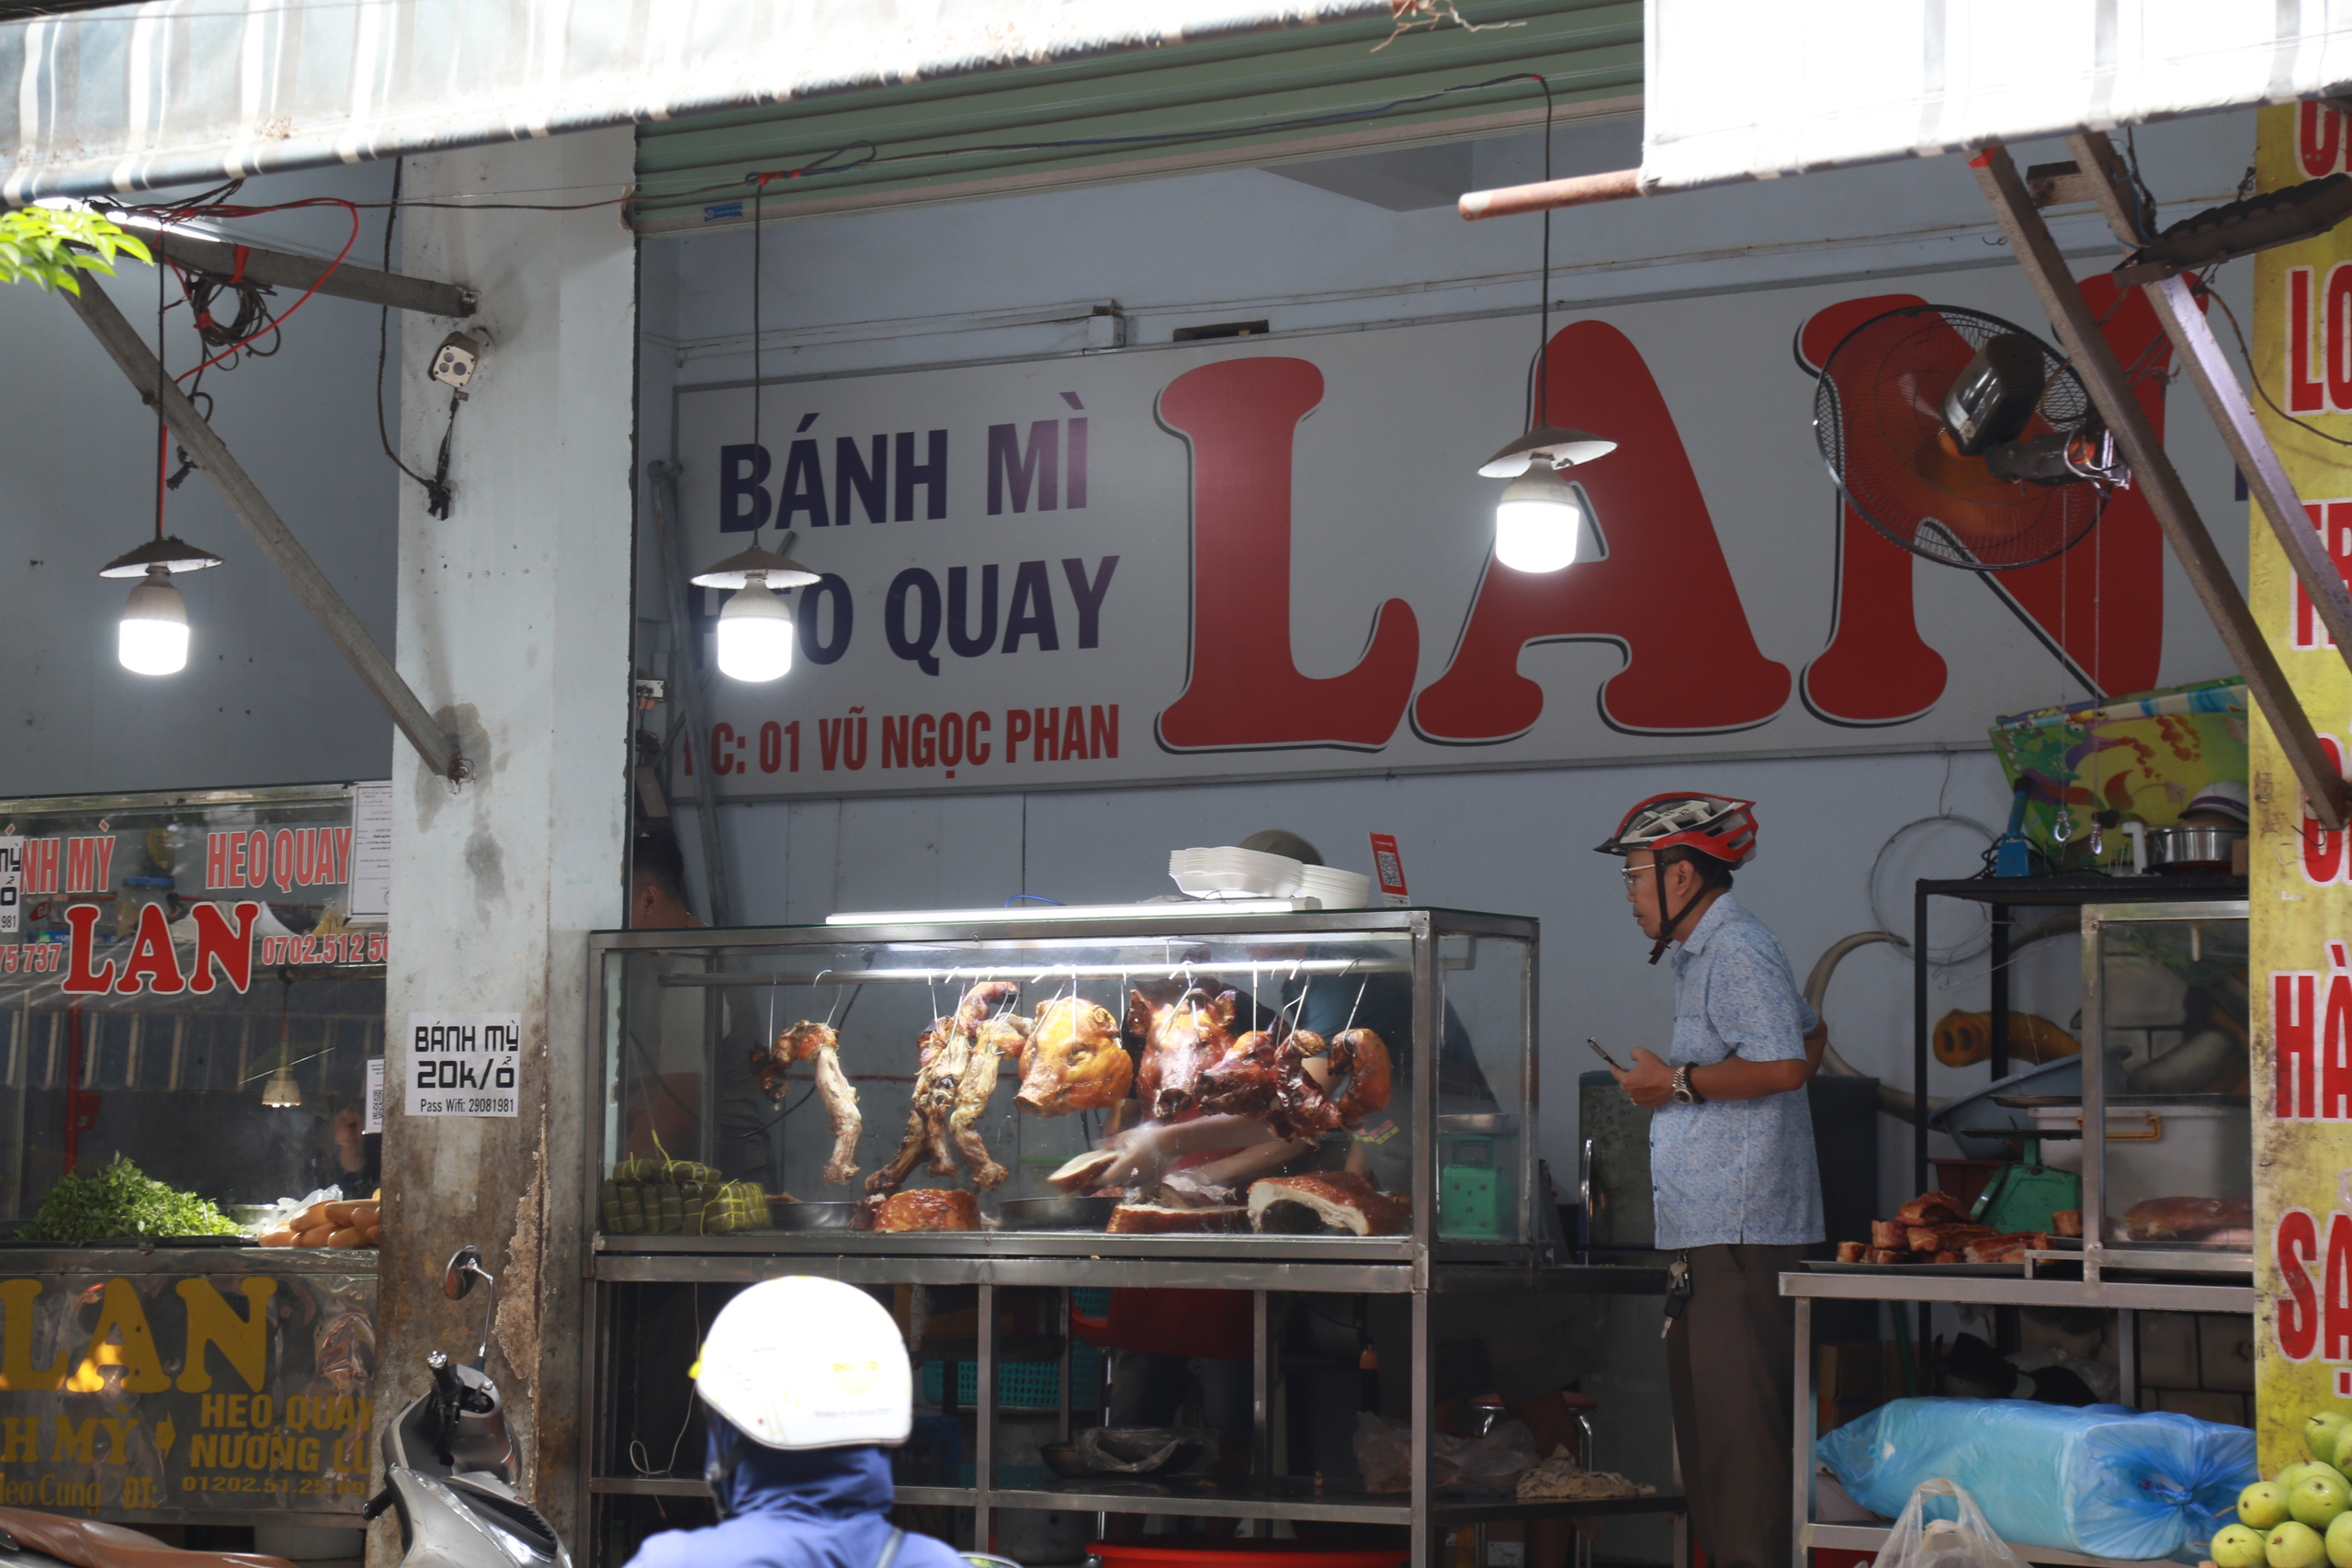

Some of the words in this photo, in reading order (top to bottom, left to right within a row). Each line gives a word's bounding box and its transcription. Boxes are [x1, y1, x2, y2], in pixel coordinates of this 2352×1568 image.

[719, 412, 948, 534] BÁNH
[987, 390, 1088, 516] MÌ
[1155, 272, 2209, 755] LAN
[688, 570, 854, 670] HO
[885, 555, 1120, 676] QUAY
[684, 723, 746, 775] C:
[760, 720, 799, 773] 01
[819, 706, 867, 772] VŨ
[881, 710, 991, 779] NGỌC
[1006, 704, 1120, 764] PHAN
[206, 829, 269, 890] HEO
[273, 826, 353, 894] QUAY
[22, 942, 62, 973] 737
[62, 902, 261, 996] LAN
[262, 933, 364, 964] 0702.512
[415, 1021, 476, 1053] BÁNH
[421, 1099, 443, 1112] Pass
[469, 1099, 514, 1112] 29081981
[0, 1276, 277, 1393] LAN
[201, 1393, 274, 1428] HEO
